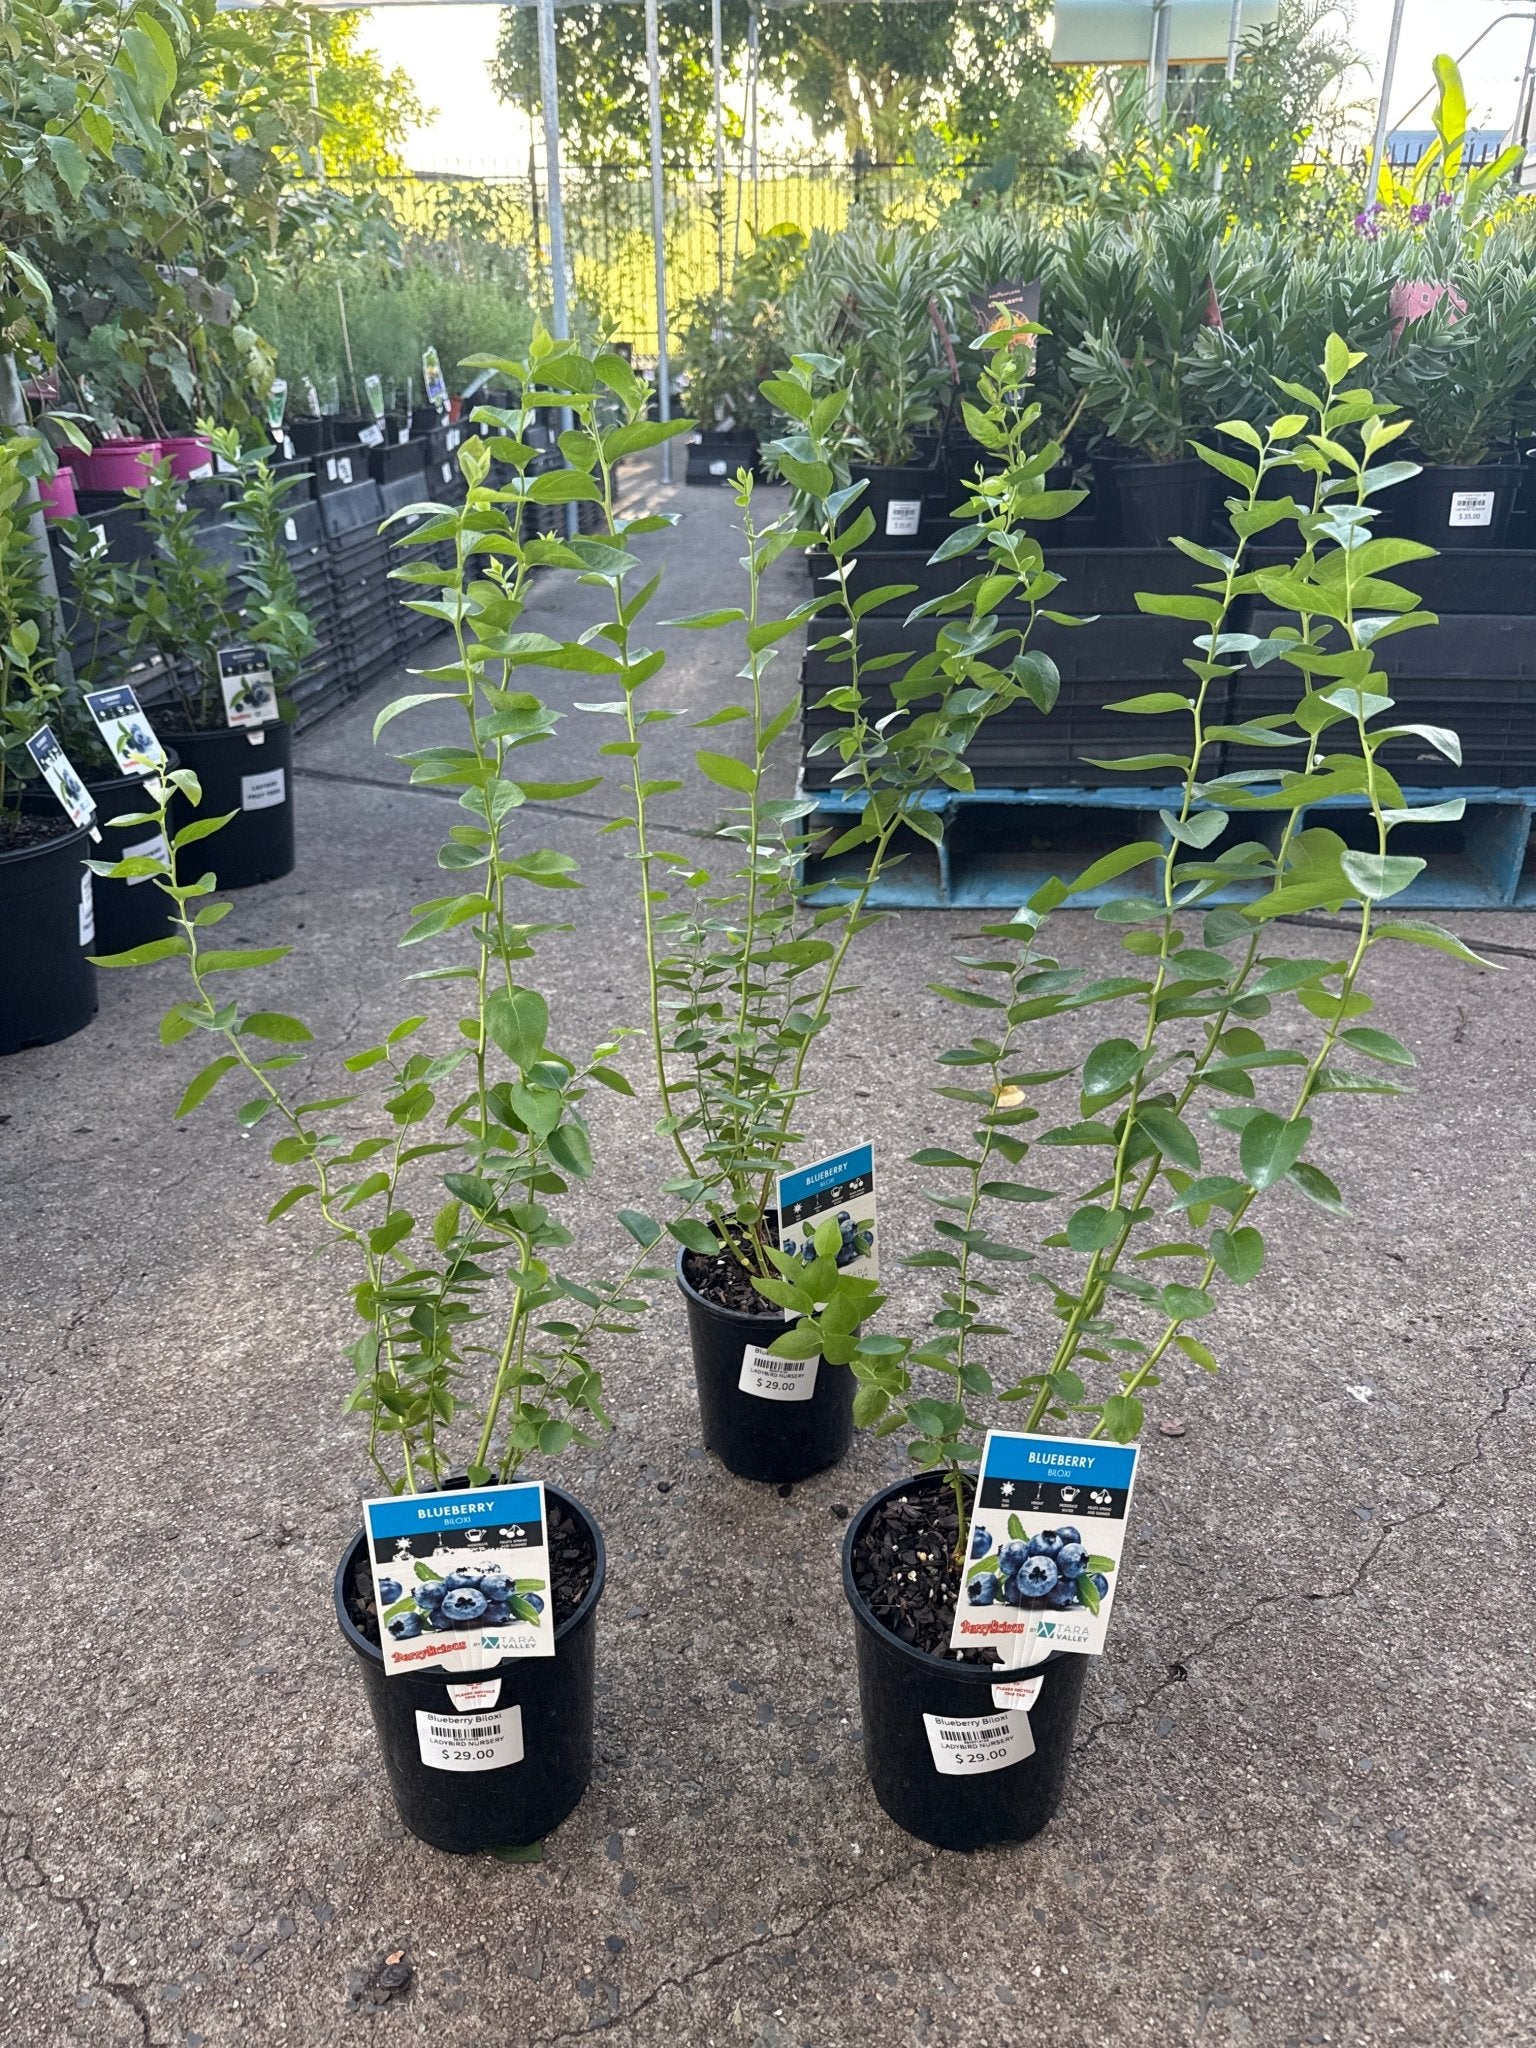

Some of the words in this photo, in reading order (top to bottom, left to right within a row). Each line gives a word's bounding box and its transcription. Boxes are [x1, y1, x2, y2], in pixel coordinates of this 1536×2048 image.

[805, 1161, 848, 1186] BLUEBERRY
[756, 1378, 763, 1388] $
[765, 1380, 795, 1391] 29.00
[1028, 1451, 1096, 1469] BLUEBERRY
[1047, 1468, 1072, 1478] BILOXI
[417, 1501, 495, 1519] BLUEBERRY
[444, 1516, 471, 1526] BILOXI
[960, 1619, 1025, 1636] Berrylicious
[1056, 1623, 1090, 1635] TARA
[501, 1636, 536, 1644] TARA
[1056, 1633, 1088, 1643] VALLEY
[390, 1640, 467, 1664] Berrylicious
[427, 1713, 474, 1726] Blueberry
[475, 1713, 502, 1723] Biloxi
[934, 1717, 980, 1727] Blueberry
[982, 1713, 1009, 1725] Biloxi
[429, 1737, 467, 1747] LADYBIRD
[468, 1736, 505, 1747] NURSERY
[940, 1742, 978, 1750] LADYBIRD
[979, 1735, 1014, 1748] NURSERY
[441, 1749, 450, 1760] $
[453, 1748, 494, 1760] 29.00
[955, 1752, 964, 1764] $
[966, 1748, 1007, 1763] 29.00
